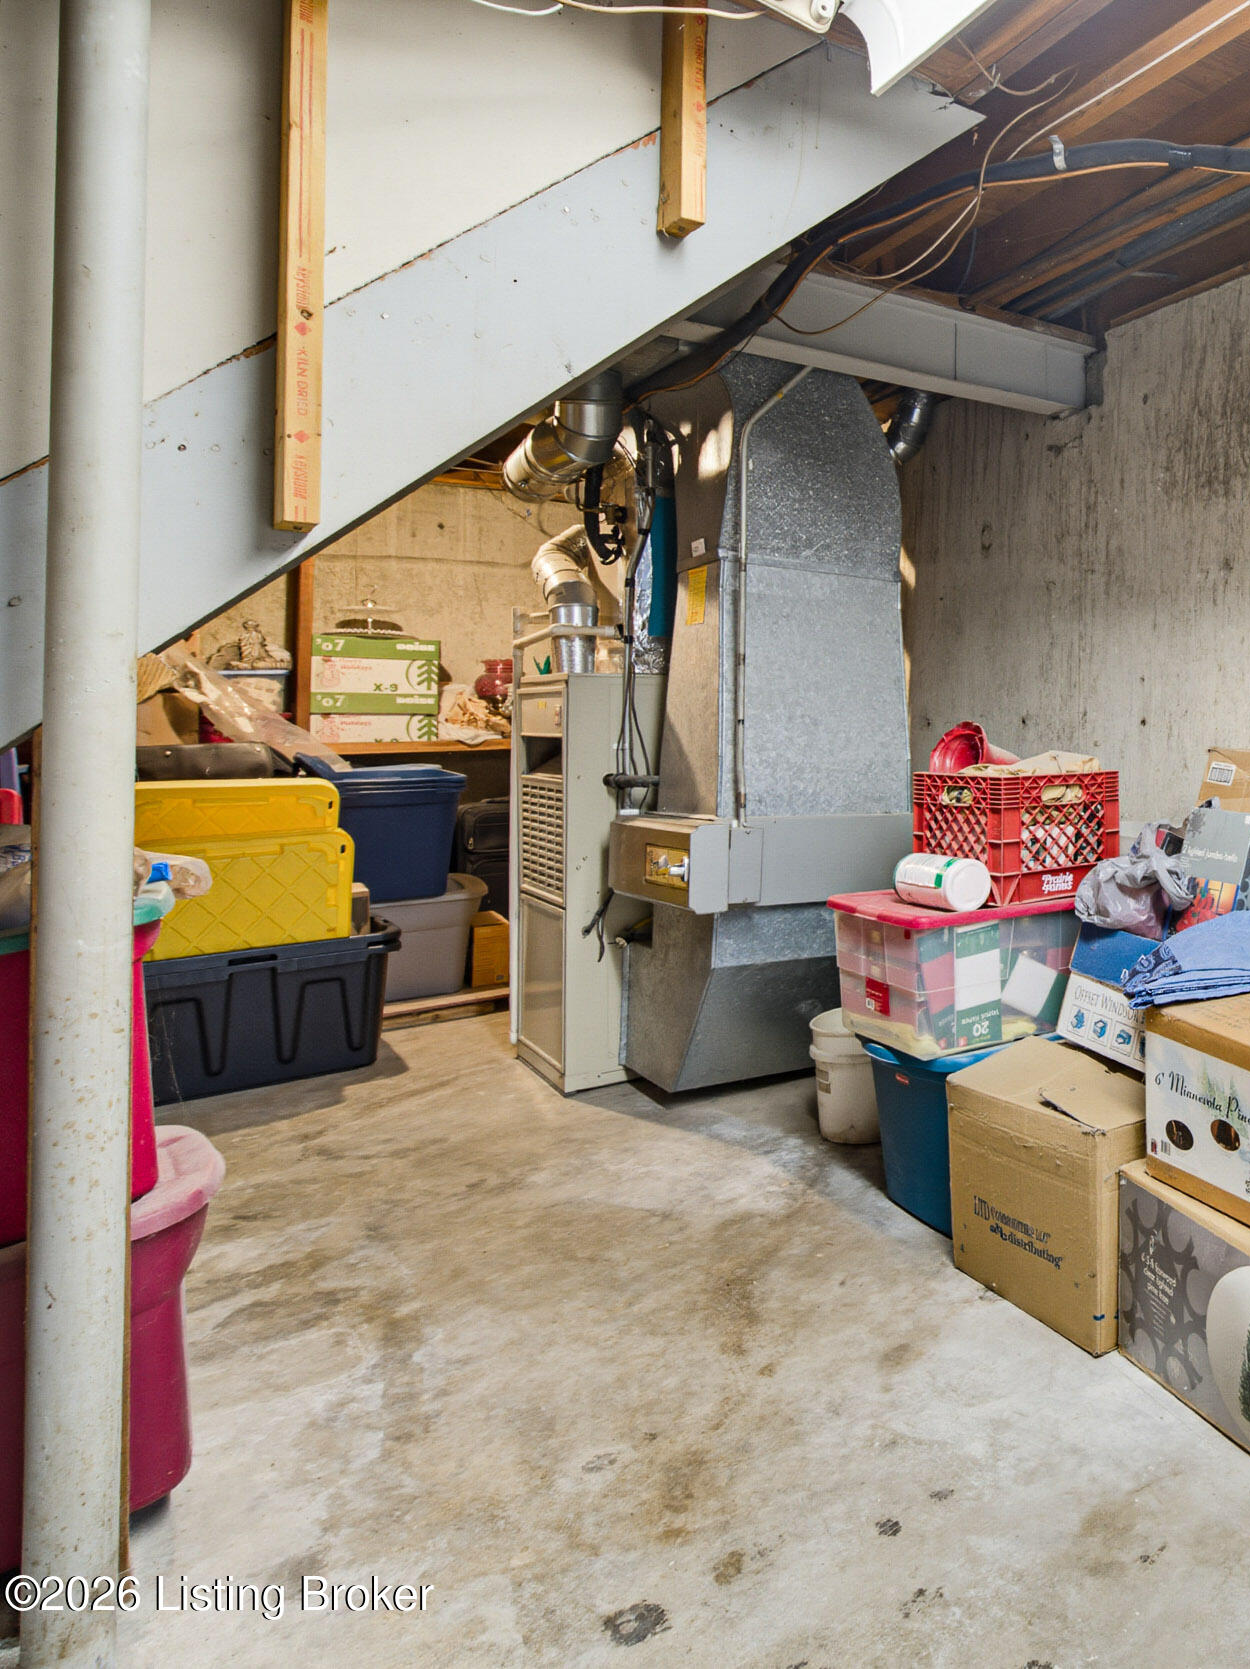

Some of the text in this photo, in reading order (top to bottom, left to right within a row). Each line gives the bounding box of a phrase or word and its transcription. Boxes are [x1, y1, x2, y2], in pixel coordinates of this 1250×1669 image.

[296, 348, 309, 417] KILN DRIED
[973, 1021, 989, 1037] 20
[1007, 1231, 1064, 1270] distributing
